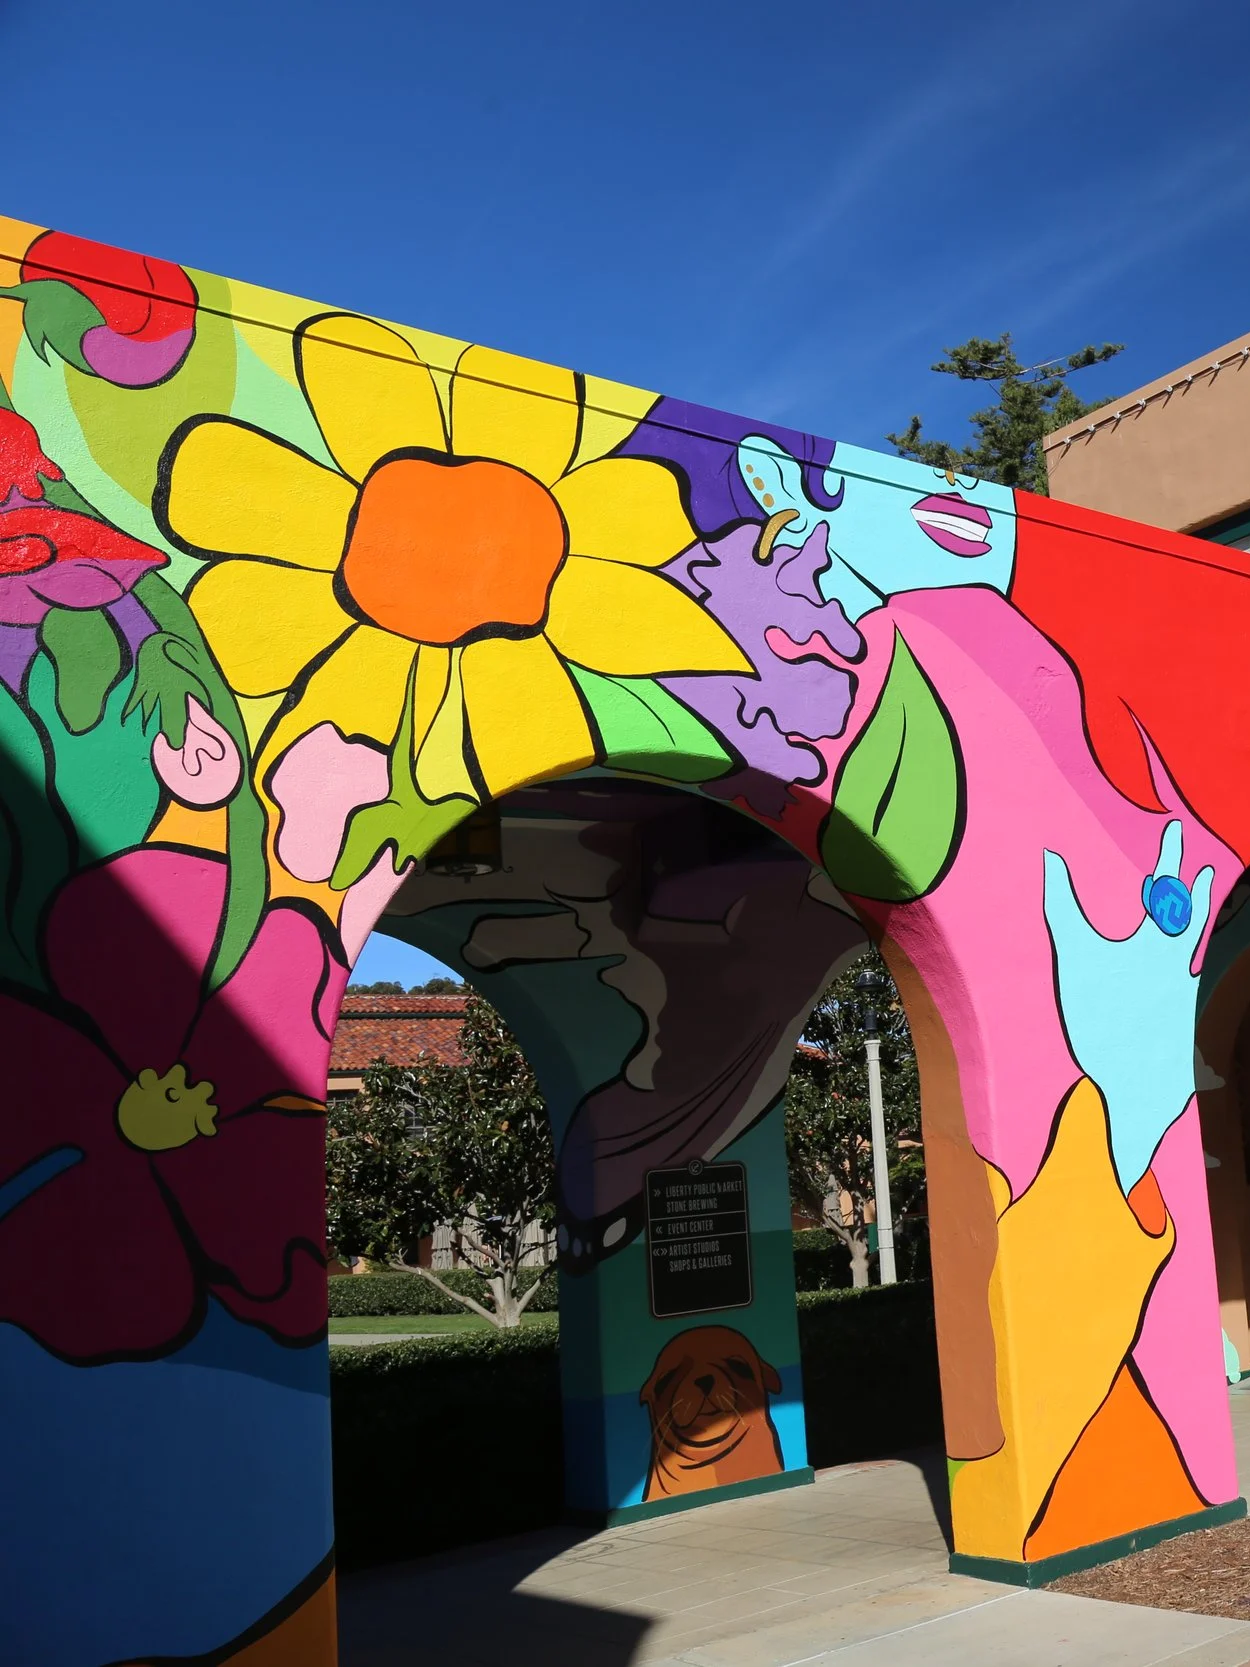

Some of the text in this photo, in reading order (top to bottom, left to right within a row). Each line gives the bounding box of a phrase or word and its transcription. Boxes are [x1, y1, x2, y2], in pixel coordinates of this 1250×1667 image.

[665, 1184, 692, 1198] LIBERTY
[693, 1182, 716, 1195] PUBLIC
[666, 1198, 718, 1213] STONE BREWING
[667, 1220, 714, 1235] EVENT CENTER
[669, 1240, 720, 1256] ARTIST STUDIOS
[669, 1254, 732, 1273] SHOPS & GALLERIES
